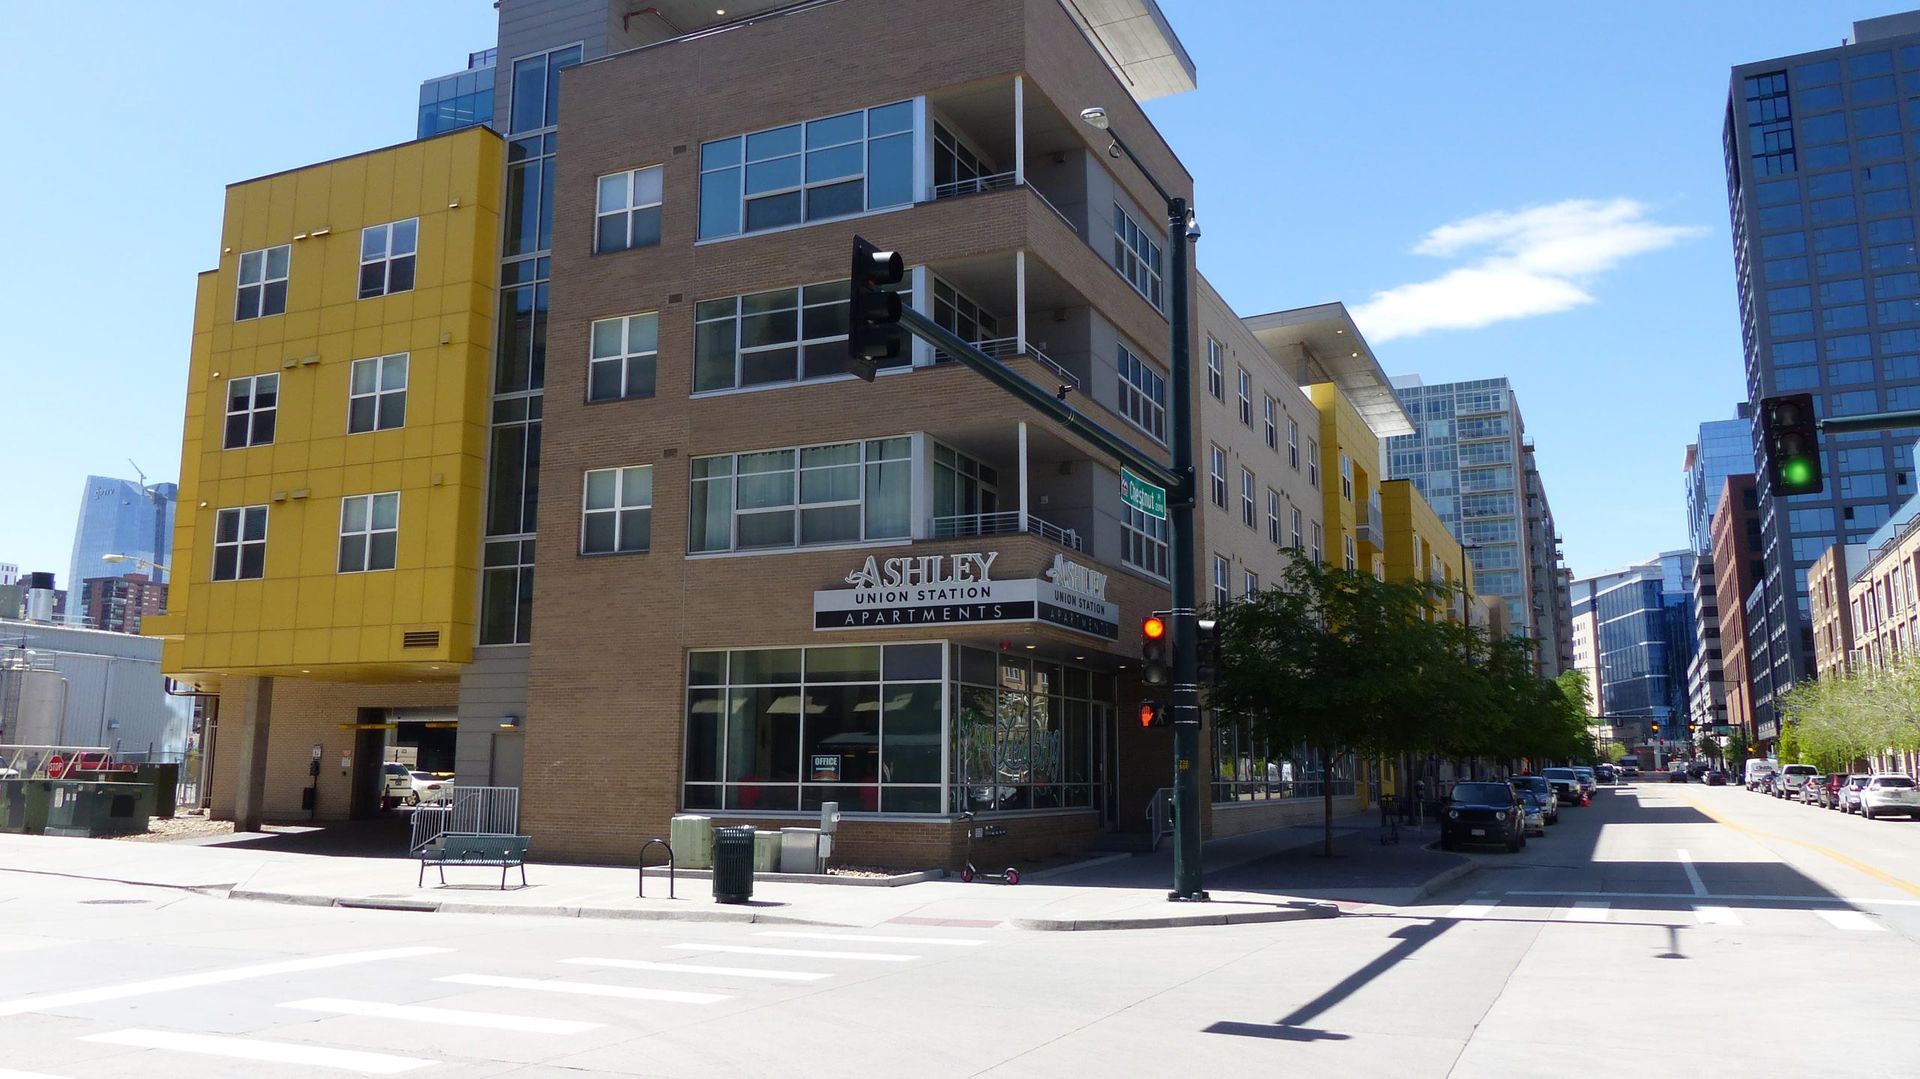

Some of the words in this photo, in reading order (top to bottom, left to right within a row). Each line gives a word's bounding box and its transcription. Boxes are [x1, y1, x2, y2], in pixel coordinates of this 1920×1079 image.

[845, 551, 998, 589] ASHLEY
[1046, 553, 1107, 601] ASHLEY
[855, 591, 908, 604] UNION
[917, 586, 991, 601] STATION
[1054, 589, 1077, 607] UNION
[1078, 597, 1105, 615] STATION
[845, 604, 1002, 625] APARTMENTS
[49, 763, 63, 771] STOP
[814, 757, 838, 766] OFFICE
